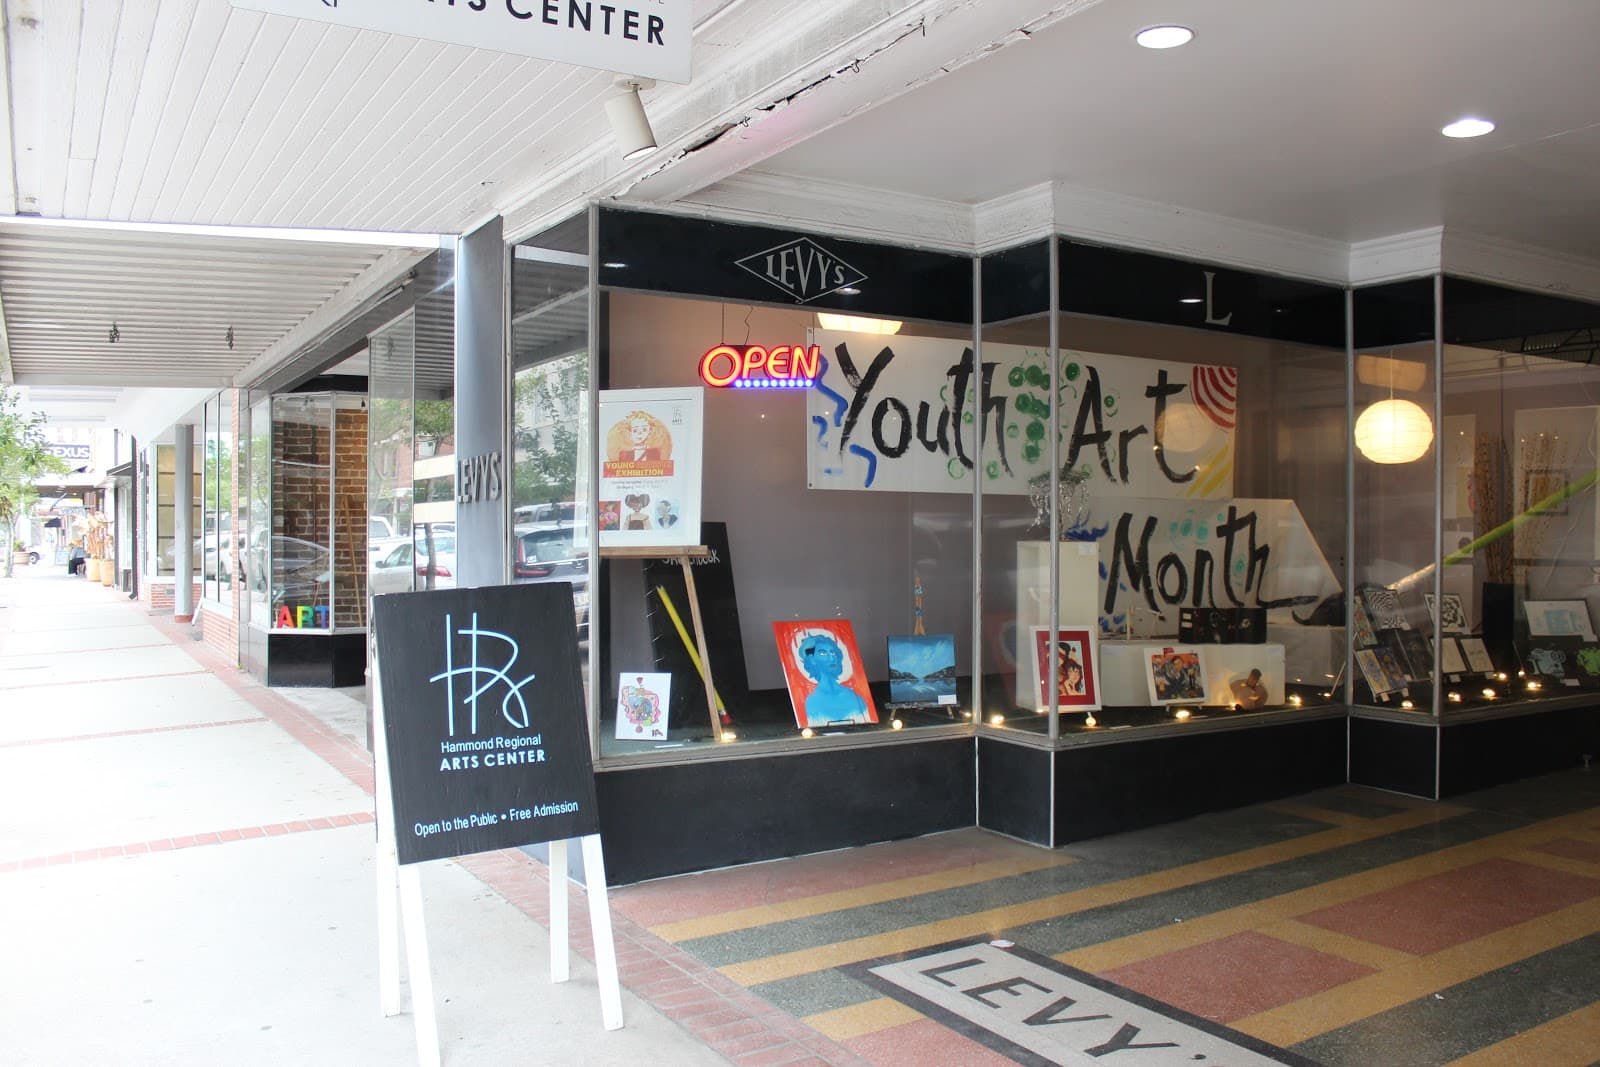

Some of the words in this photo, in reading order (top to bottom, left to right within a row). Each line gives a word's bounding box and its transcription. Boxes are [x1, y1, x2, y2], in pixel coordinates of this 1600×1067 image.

[506, 0, 665, 46] CENTER
[1203, 271, 1232, 326] L
[700, 345, 820, 387] OPEN
[834, 342, 1014, 481] Youth
[1059, 364, 1198, 484] Art
[48, 446, 90, 458] EXUS
[606, 461, 635, 469] YOUNG
[615, 468, 664, 477] EXHIBITION
[1104, 504, 1320, 621] Month
[276, 605, 330, 629] ART
[441, 738, 494, 753] Hammond
[496, 733, 542, 750] Regional
[440, 755, 479, 771] ARTS
[484, 749, 546, 767] CENTER
[414, 823, 441, 838] Open
[442, 820, 452, 832] to
[454, 816, 469, 830] the
[470, 812, 498, 828] Public
[510, 807, 531, 821] Free
[533, 800, 579, 817] Admission
